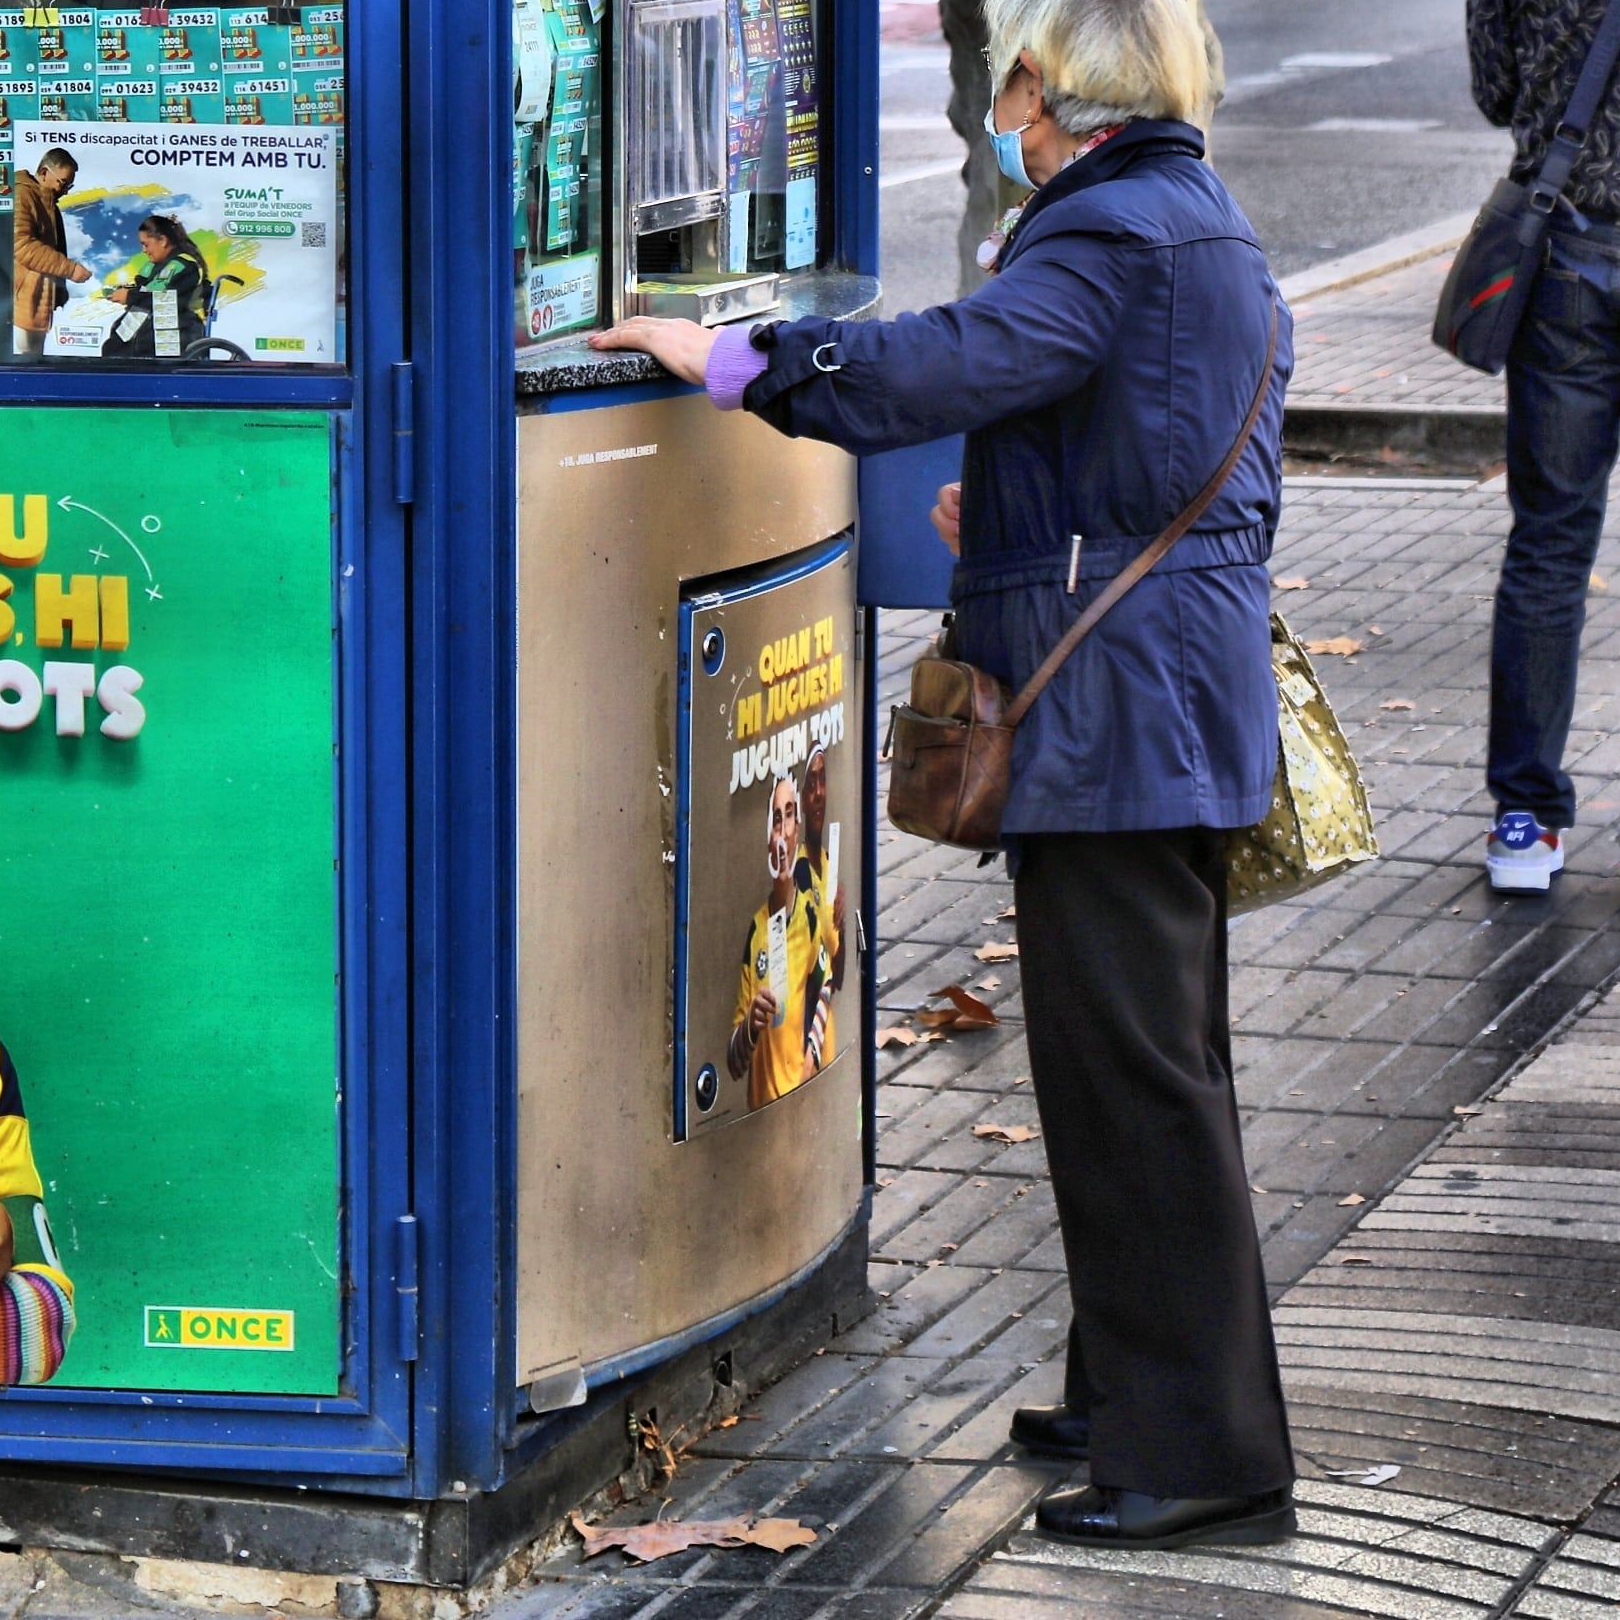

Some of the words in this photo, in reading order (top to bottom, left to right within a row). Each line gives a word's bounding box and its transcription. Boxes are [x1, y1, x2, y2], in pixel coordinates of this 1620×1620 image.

[176, 13, 214, 26] 39432
[54, 81, 92, 93] 41804
[115, 82, 154, 94] 01623
[180, 81, 218, 94] 39432
[249, 80, 287, 93] 61451
[25, 132, 37, 142] Si
[41, 132, 76, 143] TENS
[80, 133, 158, 146] discapacitat
[169, 134, 217, 147] GANES
[221, 135, 237, 147] de
[131, 149, 235, 167] COMPTEM
[241, 152, 288, 168] AMB
[294, 153, 327, 169] TU.
[270, 202, 313, 210] VENEDORS
[237, 210, 255, 218] Grup
[257, 210, 279, 218] Social
[239, 224, 254, 233] 912
[268, 339, 305, 350] ONCE
[35, 573, 129, 651] HI
[759, 627, 811, 685] QUAN
[814, 616, 833, 660] TU
[737, 692, 762, 741] HI
[730, 720, 808, 795] JUGUEM
[810, 701, 845, 750] TOTS
[189, 1316, 284, 1343] ONCE
